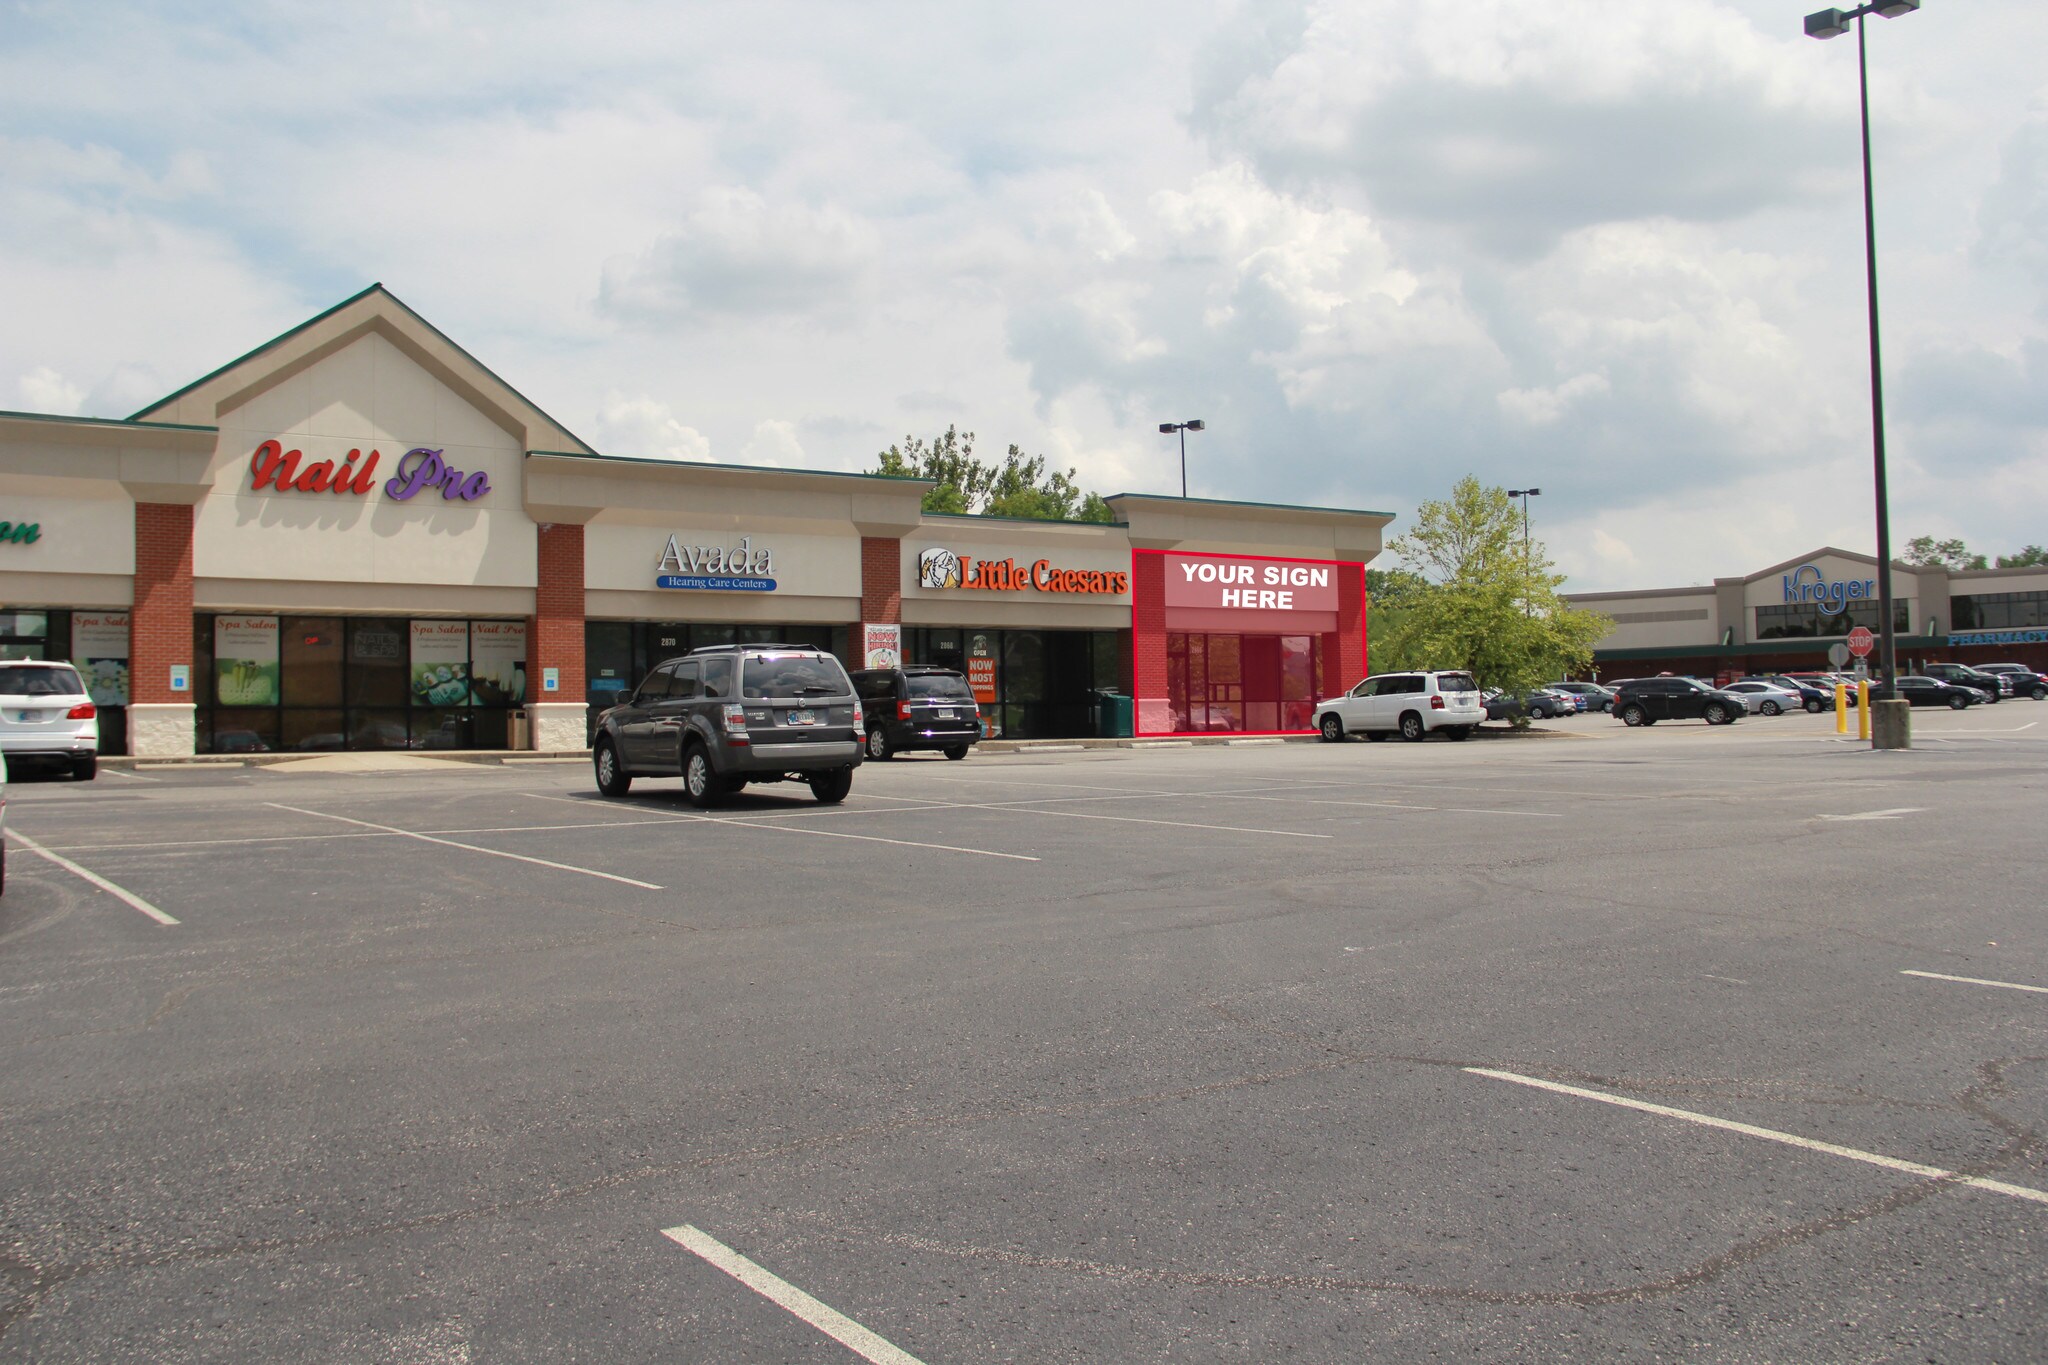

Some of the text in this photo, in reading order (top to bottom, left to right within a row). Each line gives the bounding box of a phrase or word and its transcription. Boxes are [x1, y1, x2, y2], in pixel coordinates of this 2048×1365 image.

[251, 439, 491, 500] Nail Pro
[656, 533, 776, 575] Avada
[956, 555, 1129, 594] Little Caesars
[669, 576, 767, 588] Hearing Care Centers
[1782, 563, 1875, 616] Kroger
[74, 615, 99, 628] Spa
[217, 618, 277, 630] Spa Salon
[412, 623, 466, 635] Spa Salon
[473, 624, 525, 634] Nail Pro
[357, 635, 397, 645] NAILS
[661, 638, 676, 646] 2870
[867, 631, 898, 641] NOW
[1849, 636, 1871, 647] STOP
[1947, 630, 2048, 646] PHARMACY
[372, 645, 396, 655] SPA
[969, 660, 993, 670] NOW
[970, 673, 994, 682] MOST
